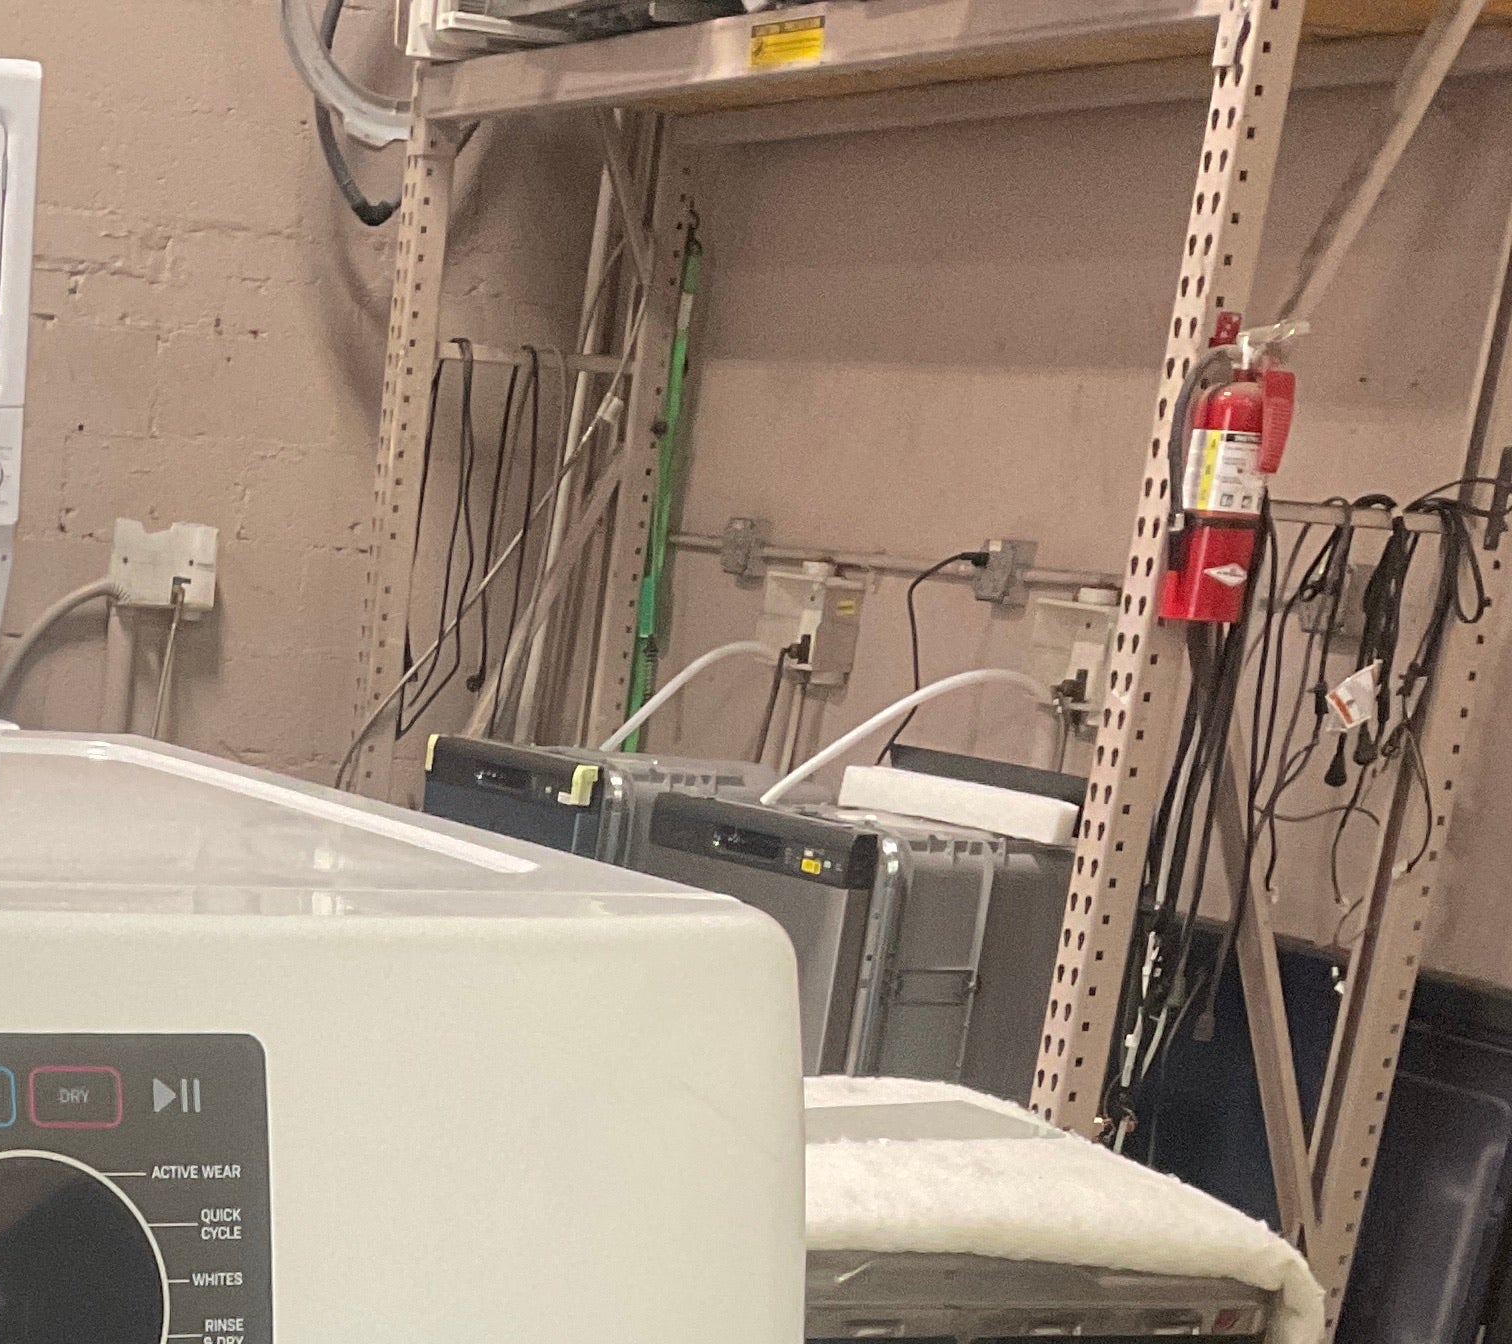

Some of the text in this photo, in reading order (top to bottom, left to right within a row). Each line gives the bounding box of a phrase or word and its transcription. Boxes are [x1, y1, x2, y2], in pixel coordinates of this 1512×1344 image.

[59, 1087, 89, 1104] DRY
[151, 1164, 241, 1179] ACTIVE WEAR
[200, 1208, 242, 1224] QUICK
[201, 1225, 242, 1240] CYCLE
[192, 1271, 243, 1287] WHITES
[204, 1317, 245, 1332] RINSE
